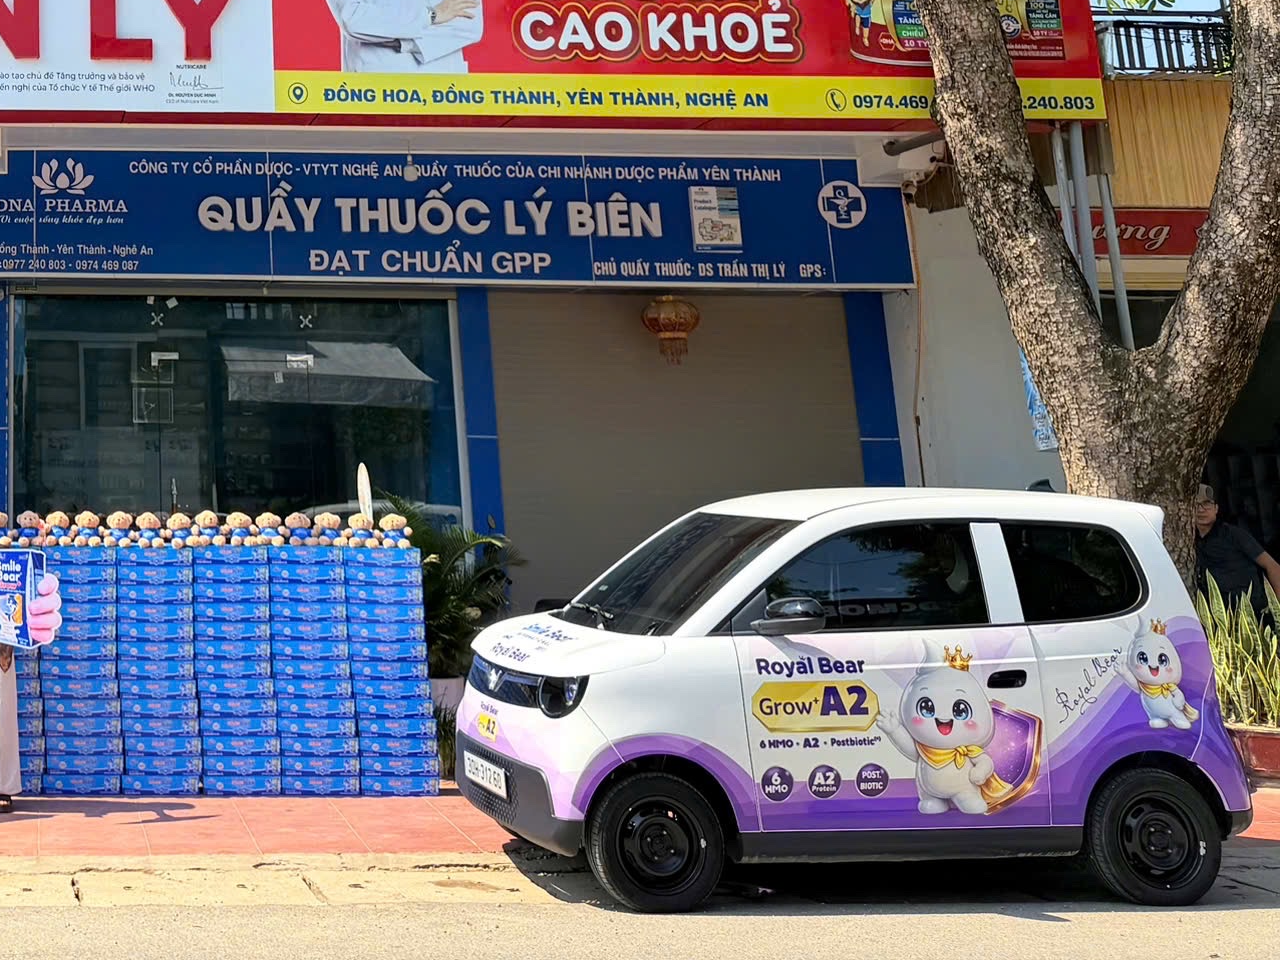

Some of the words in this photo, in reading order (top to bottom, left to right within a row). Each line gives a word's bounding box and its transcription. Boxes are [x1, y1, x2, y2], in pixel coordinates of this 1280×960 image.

[519, 11, 634, 52] CAO
[647, 0, 795, 54] KHOẺ
[323, 82, 376, 103] ĐỒNG
[382, 88, 427, 106] HOA,
[432, 83, 485, 105] ĐỒNG
[492, 85, 561, 108] THÀNH,
[566, 85, 604, 106] YÊN
[610, 86, 680, 109] THÀNH,
[685, 87, 737, 109] NGHỆ
[743, 93, 769, 107] AN
[129, 159, 168, 174] CÔNG
[171, 162, 189, 174] TY
[192, 156, 214, 174] CỔ
[216, 158, 252, 175] PHẦN
[255, 161, 293, 178] DƯỢC
[302, 163, 339, 175] VTYT
[342, 161, 379, 179] NGHỆ
[383, 165, 402, 177] AN
[454, 160, 502, 177] THUỐC
[505, 160, 536, 178] CỦA
[538, 166, 561, 179] CHI
[564, 161, 612, 180] NHÁNH
[615, 166, 655, 183] DƯỢC
[658, 161, 698, 181] PHẨM
[701, 162, 732, 181] YÊN
[735, 162, 782, 182] THÀNH
[44, 199, 129, 213] PHARMA
[197, 180, 322, 234] QUẦY
[334, 182, 492, 237] THUỐC
[504, 186, 554, 237] LÝ
[567, 192, 664, 238] BIÊN
[56, 243, 74, 255] Yên
[77, 243, 106, 255] Thành
[140, 244, 154, 255] An
[309, 250, 370, 276] ĐẠT
[381, 240, 483, 274] CHUẨN
[491, 252, 553, 274] GPP
[28, 258, 46, 270] 240
[48, 259, 66, 270] 803
[75, 259, 99, 271] 0974
[101, 259, 119, 271] 469
[121, 260, 139, 271] 087
[698, 262, 714, 277] DS
[751, 262, 770, 280] THỊ
[799, 262, 827, 277] GPS:
[755, 656, 814, 678] Royal
[817, 657, 865, 674] Bear
[1055, 668, 1097, 724] Royal
[1091, 646, 1122, 677] Bear
[820, 685, 869, 716] A2
[759, 739, 767, 748] 6
[769, 739, 794, 748] HMO
[803, 738, 820, 748] A2
[771, 772, 781, 785] 6
[813, 772, 835, 785] A2
[860, 782, 884, 790] BIOTIC
[765, 785, 789, 794] HMO
